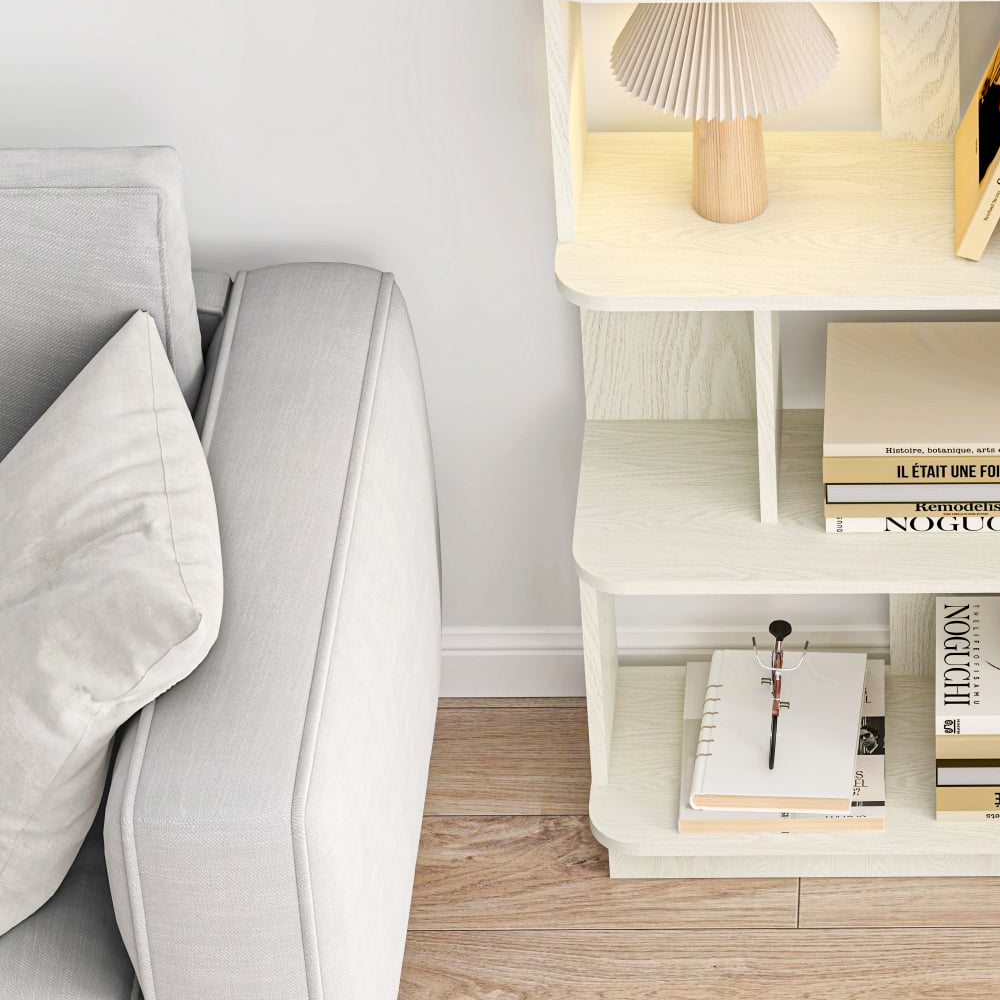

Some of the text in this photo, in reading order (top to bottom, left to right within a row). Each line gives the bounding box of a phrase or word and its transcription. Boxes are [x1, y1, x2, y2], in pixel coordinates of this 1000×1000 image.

[885, 447, 925, 455] Histoire,
[927, 447, 974, 455] botanique,
[897, 465, 908, 478] IL
[912, 463, 946, 478] ÉTAIT
[951, 465, 977, 478] UNE
[943, 604, 971, 706] NOGUCHI
